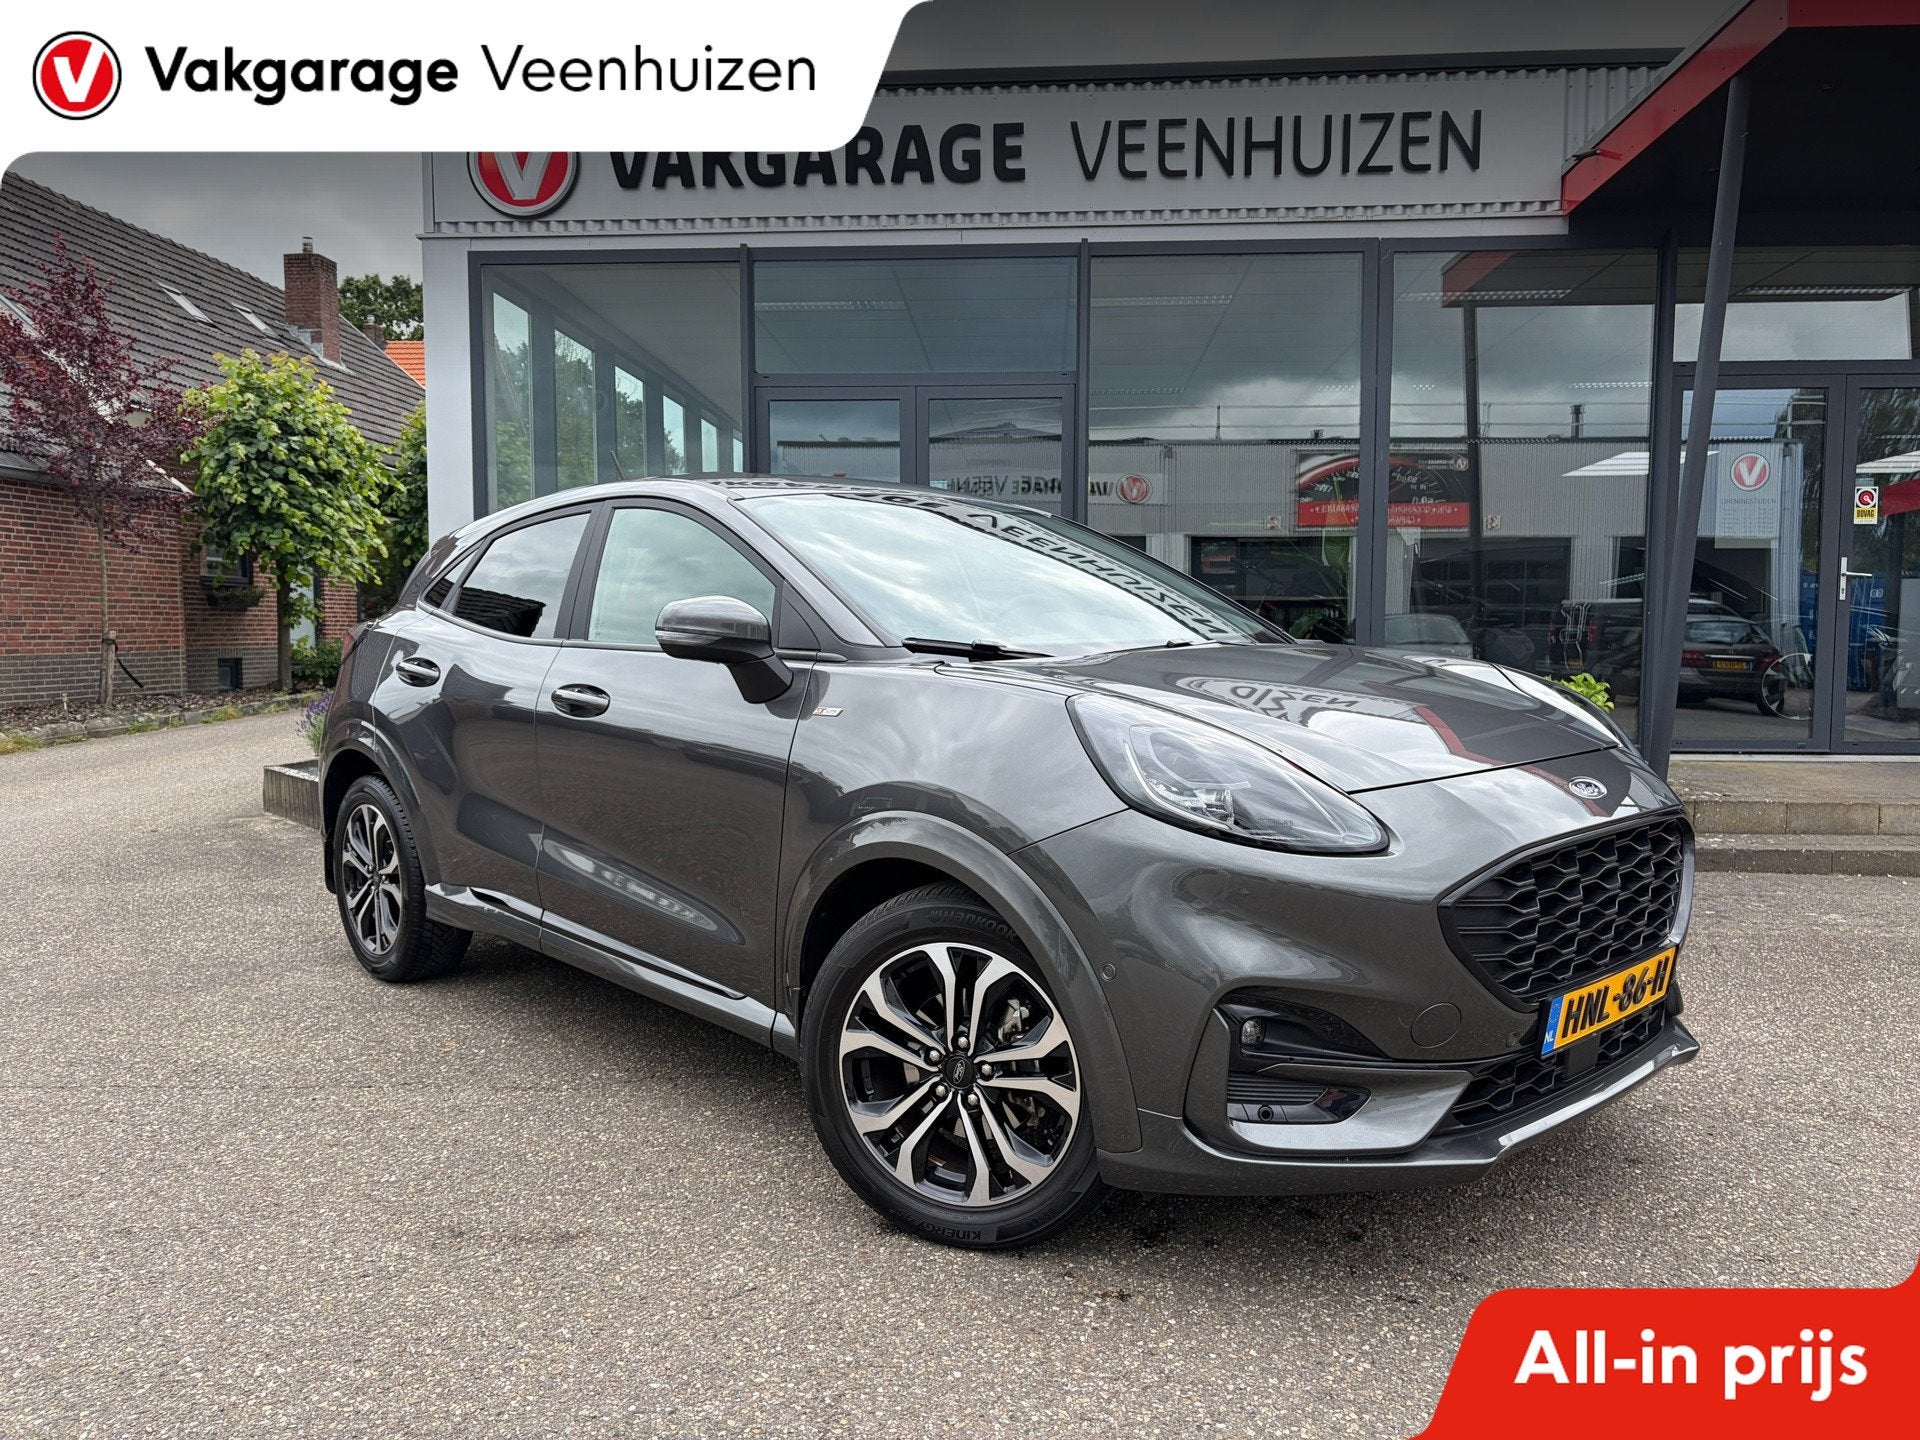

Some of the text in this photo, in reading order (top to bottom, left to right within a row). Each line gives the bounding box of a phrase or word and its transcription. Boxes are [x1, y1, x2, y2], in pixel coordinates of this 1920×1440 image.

[1070, 109, 1483, 181] VEENHUIZEN
[1856, 509, 1875, 518] BOVAG
[1561, 955, 1670, 1038] HNL-86-H
